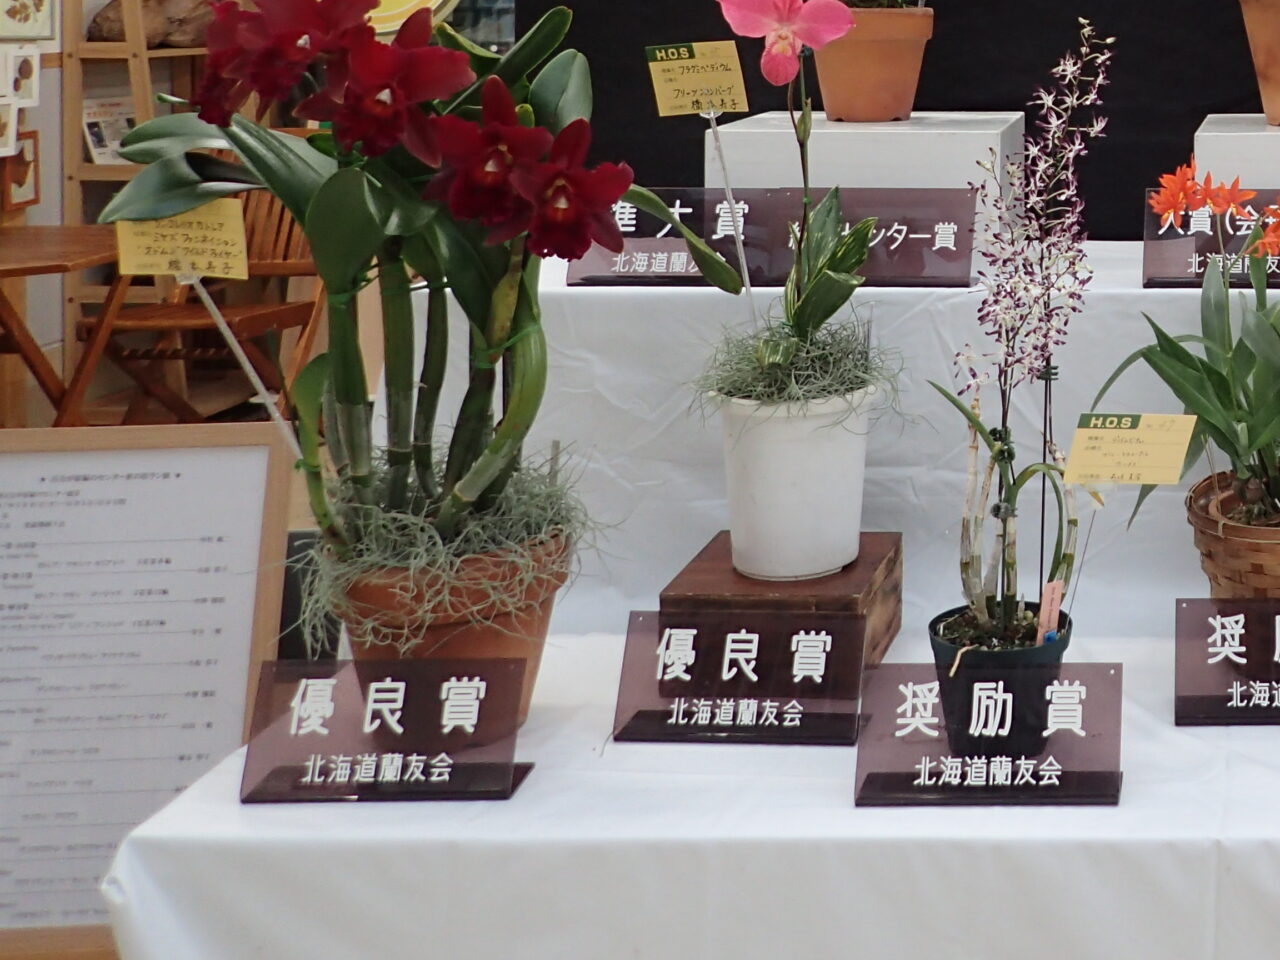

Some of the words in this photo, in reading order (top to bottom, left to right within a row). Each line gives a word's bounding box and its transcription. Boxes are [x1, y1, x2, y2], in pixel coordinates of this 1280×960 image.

[656, 47, 690, 61] H.O.S
[1090, 416, 1132, 428] H.O.S
[656, 628, 832, 683] 優良賞
[290, 677, 486, 735] 優良賞
[667, 698, 804, 726] 北海道蘭友会
[895, 680, 1087, 737] 奨励賞
[301, 752, 454, 783] 北海道蘭友会
[913, 755, 1062, 786] 北海道蘭友会
